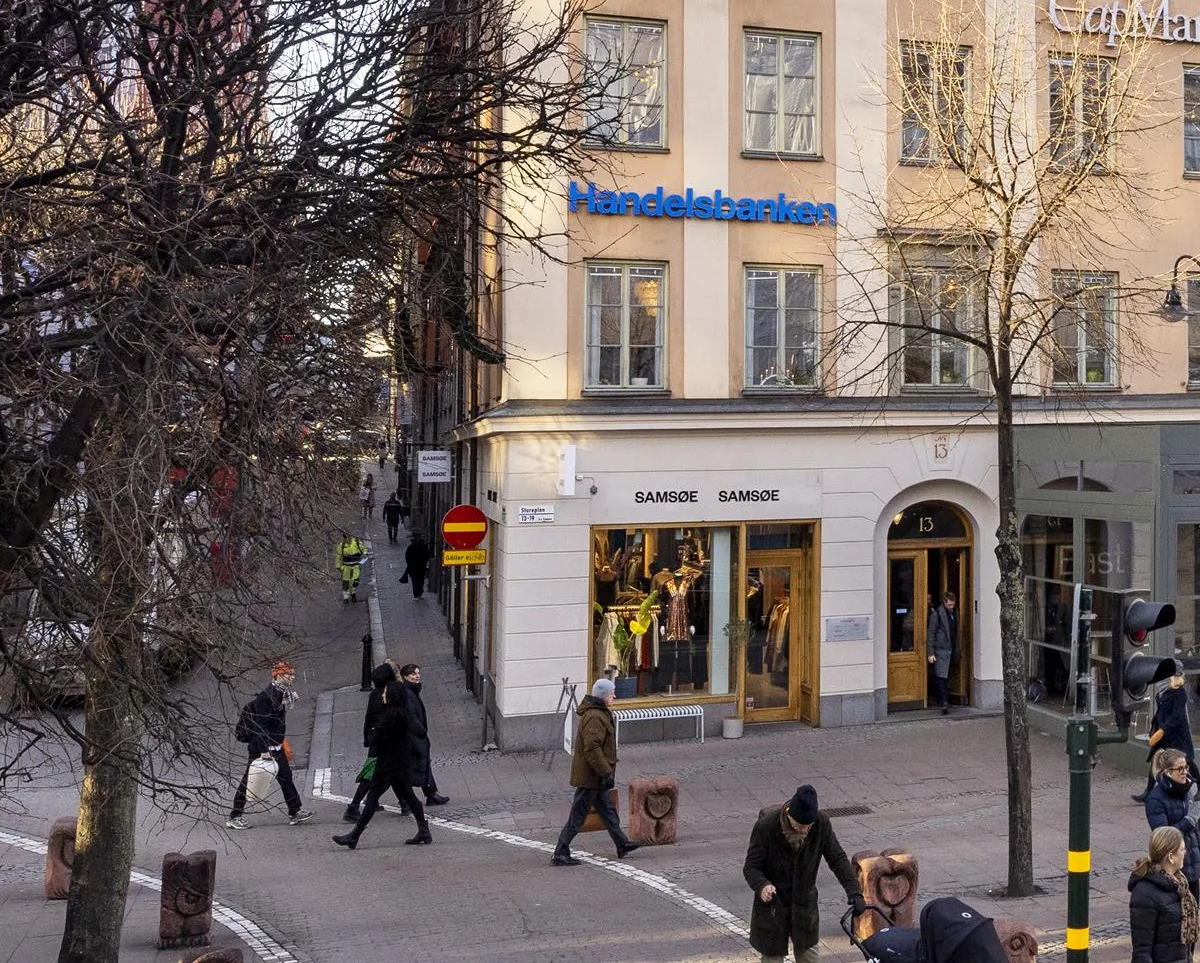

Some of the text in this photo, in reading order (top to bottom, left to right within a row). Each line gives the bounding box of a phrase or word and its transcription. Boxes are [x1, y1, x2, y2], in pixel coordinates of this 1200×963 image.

[568, 180, 838, 227] Handelsbanken
[934, 443, 948, 459] 13
[634, 489, 780, 504] SAMSØE SAMSØE
[919, 517, 934, 533] 13
